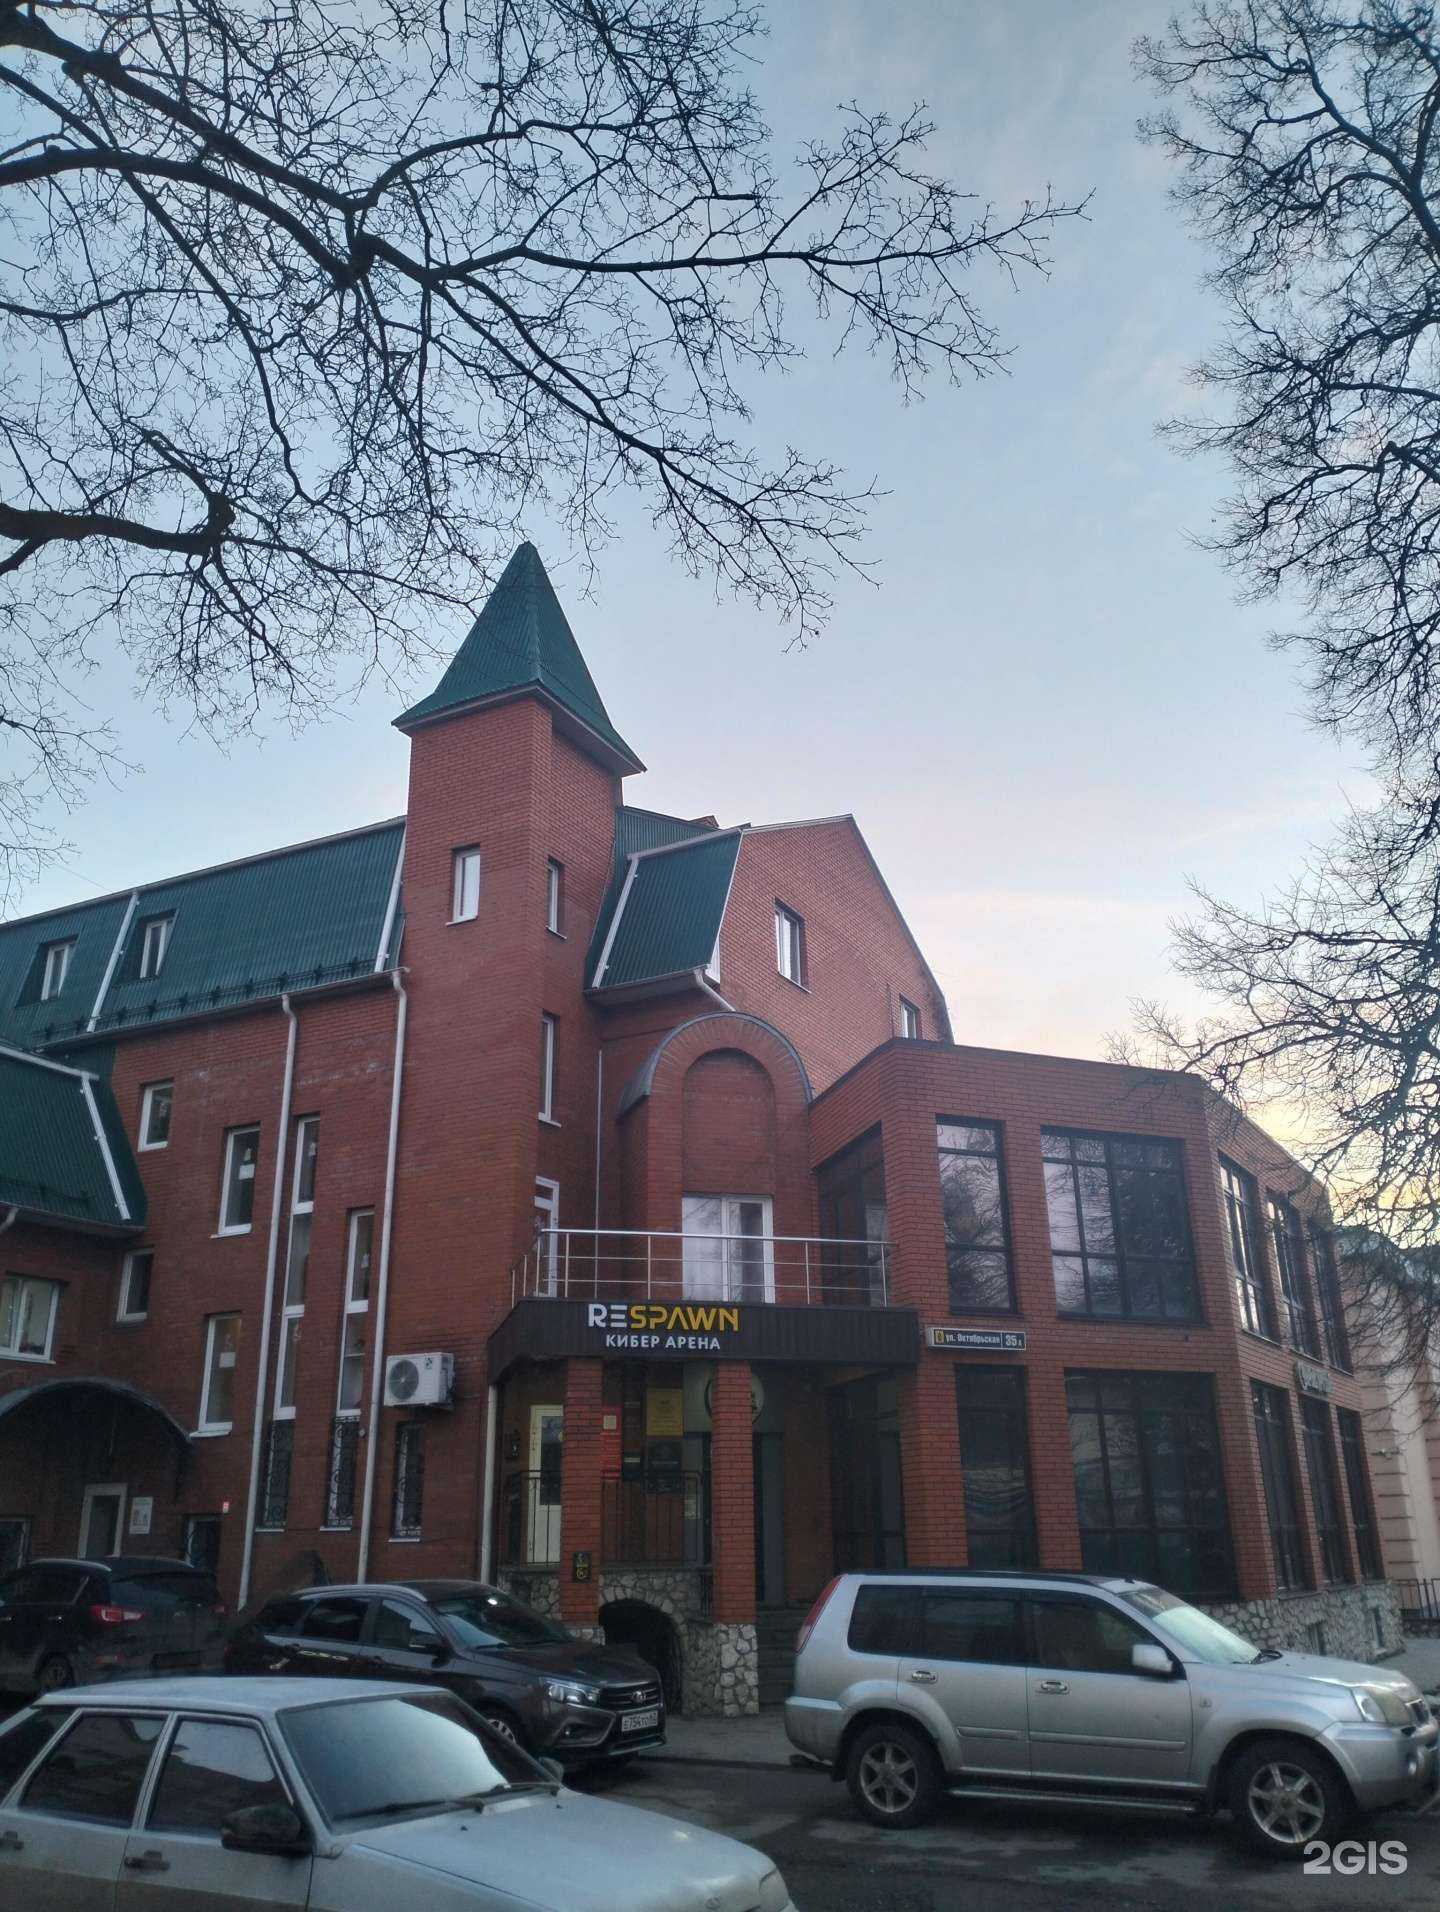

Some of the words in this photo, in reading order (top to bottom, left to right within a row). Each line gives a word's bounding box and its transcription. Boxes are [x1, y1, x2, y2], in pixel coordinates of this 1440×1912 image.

[588, 1303, 740, 1331] RESPAWN
[606, 1334, 660, 1349] КИБЕР
[665, 1336, 721, 1350] АРЕНА
